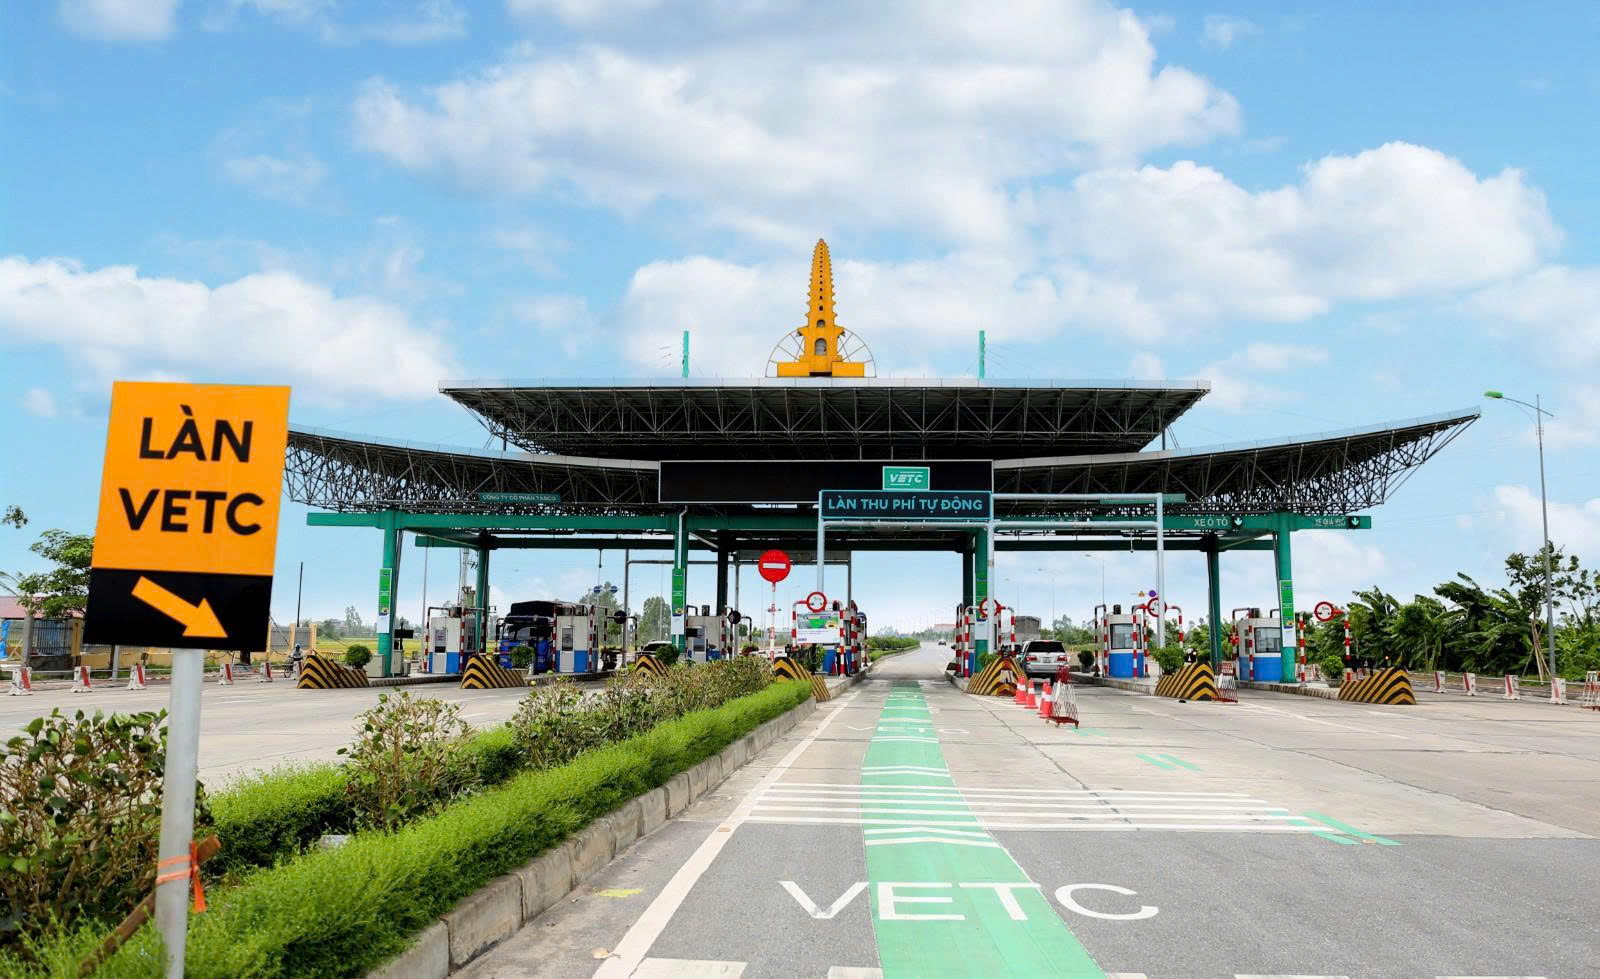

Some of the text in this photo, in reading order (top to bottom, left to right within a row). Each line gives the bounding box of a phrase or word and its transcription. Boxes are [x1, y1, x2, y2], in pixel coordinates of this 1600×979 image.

[139, 404, 253, 463] LÀN
[889, 473, 923, 483] VETC
[118, 487, 264, 536] VETC
[828, 495, 982, 514] LÀN THU PHÍ TỰ ĐỘNG
[1194, 518, 1206, 527] XE
[1216, 517, 1228, 527] TÔ
[778, 880, 1160, 921] VETC
